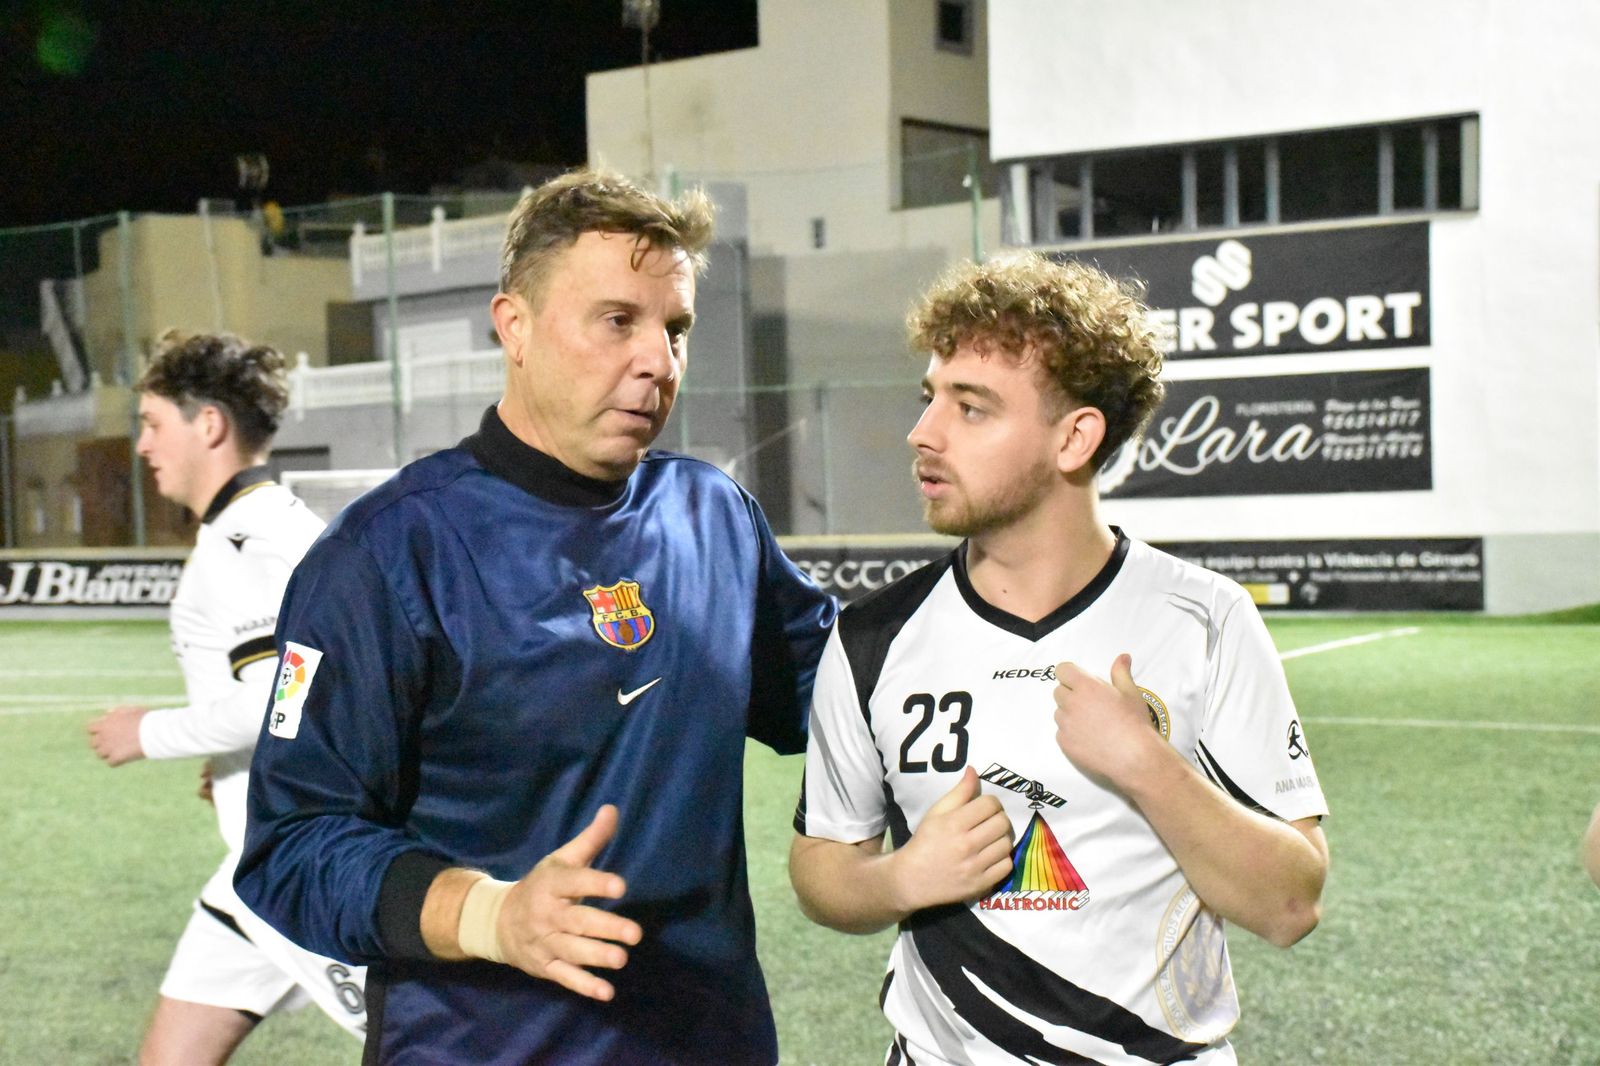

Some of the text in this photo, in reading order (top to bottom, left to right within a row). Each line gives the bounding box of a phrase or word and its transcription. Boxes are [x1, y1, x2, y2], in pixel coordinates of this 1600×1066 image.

[1230, 292, 1421, 350] SPORT
[1139, 396, 1322, 475] Lara
[899, 691, 973, 773] 23
[979, 894, 1085, 911] HALTRONIC
[326, 963, 367, 1014] 6
